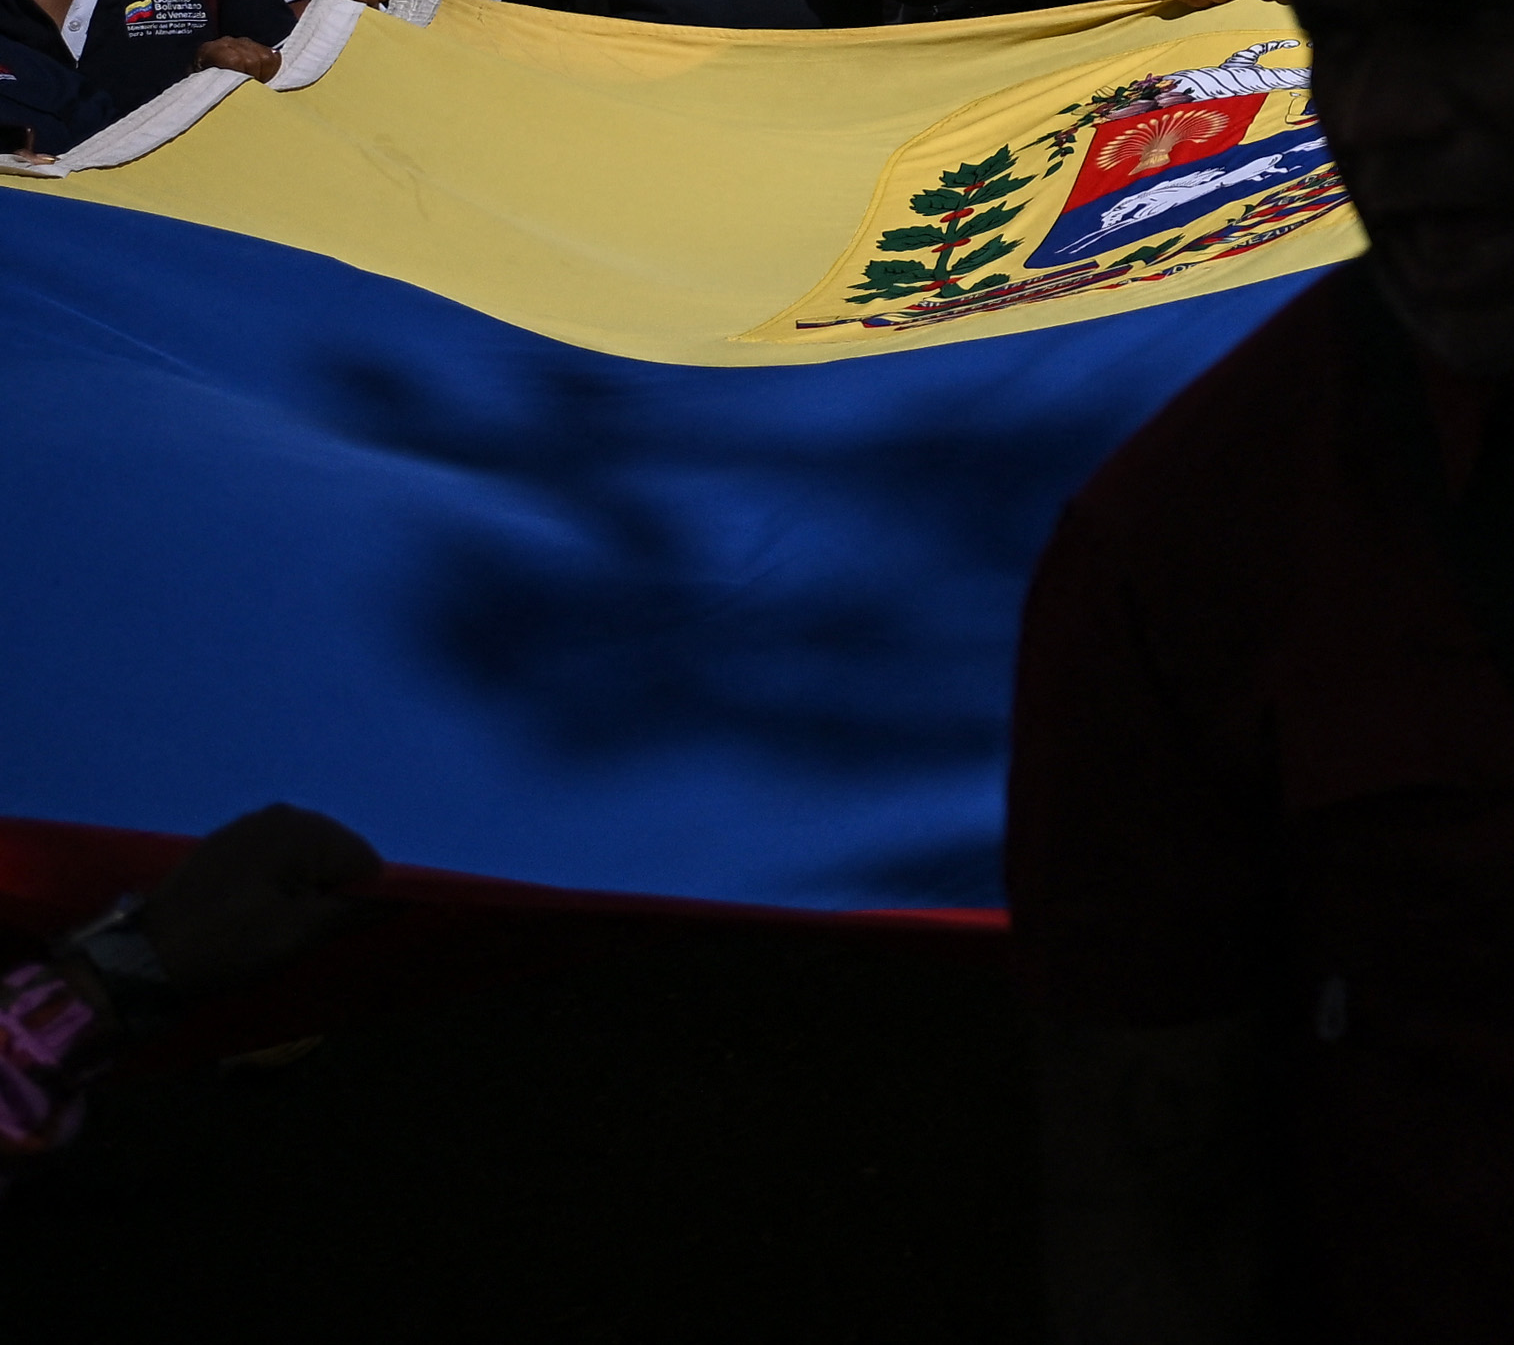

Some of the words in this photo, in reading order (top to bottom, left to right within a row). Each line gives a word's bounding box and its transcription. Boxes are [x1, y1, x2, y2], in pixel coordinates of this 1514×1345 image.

[154, 2, 203, 11] Bolivariano
[155, 11, 168, 20] de
[167, 10, 207, 20] Venezuela
